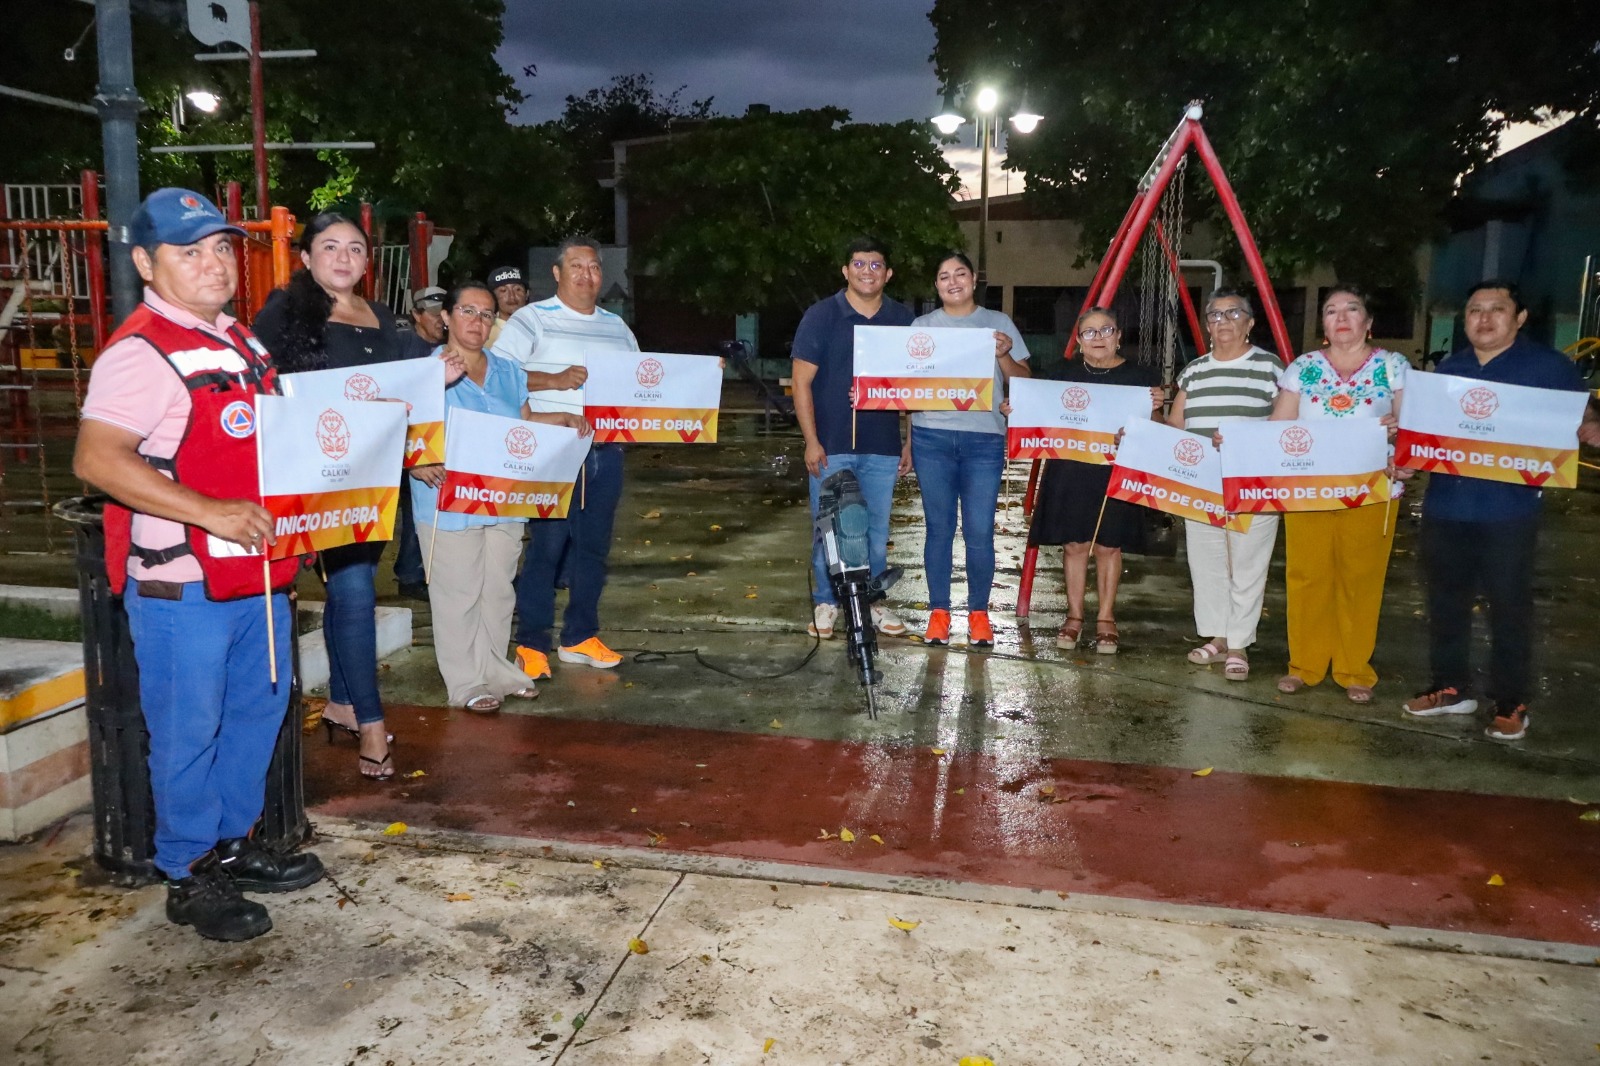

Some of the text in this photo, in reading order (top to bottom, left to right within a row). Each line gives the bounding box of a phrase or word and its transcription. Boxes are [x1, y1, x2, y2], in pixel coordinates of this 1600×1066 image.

[495, 271, 521, 282] adidas
[867, 387, 978, 399] INICIO DE OBRA
[595, 417, 704, 431] INICIO DE OBRA
[1020, 437, 1118, 455] INICIO DE OBR
[1410, 444, 1556, 475] INICIO DE OBRA
[454, 485, 559, 506] INICIO DE OBRA
[1120, 478, 1236, 520] INICIO DE OBR
[1239, 484, 1371, 500] INICIO DE OBRA
[275, 505, 379, 537] INICIO DE OBRA
